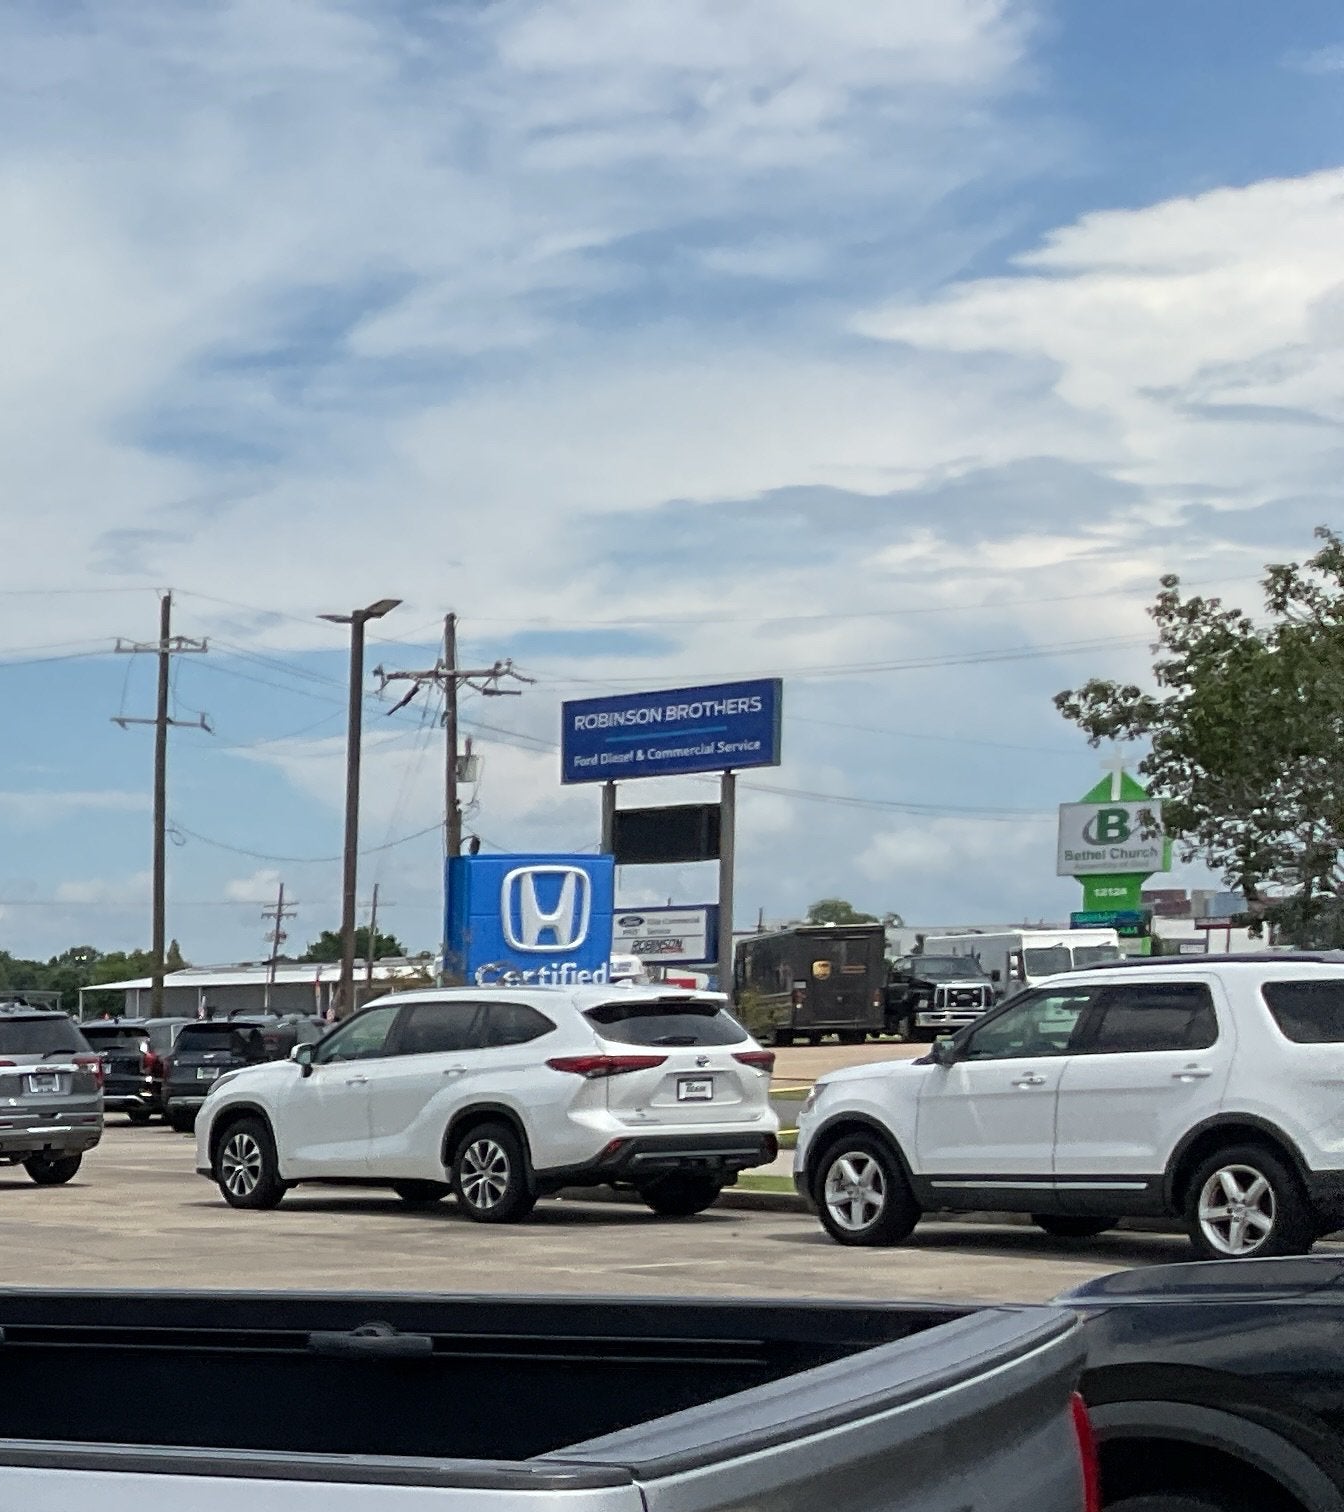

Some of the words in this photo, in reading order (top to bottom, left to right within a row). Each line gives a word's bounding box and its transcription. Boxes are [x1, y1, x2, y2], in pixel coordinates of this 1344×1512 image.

[574, 708, 662, 731] ROBINSON
[665, 696, 763, 722] BROTHERS
[574, 754, 599, 768] Ford
[600, 751, 633, 766] Diesel
[636, 749, 644, 761] &
[647, 742, 714, 760] Commercial
[717, 739, 761, 753] Service
[1096, 808, 1130, 842] B
[1064, 849, 1106, 861] Bethel
[1109, 846, 1159, 860] Church
[475, 962, 608, 986] Certified
